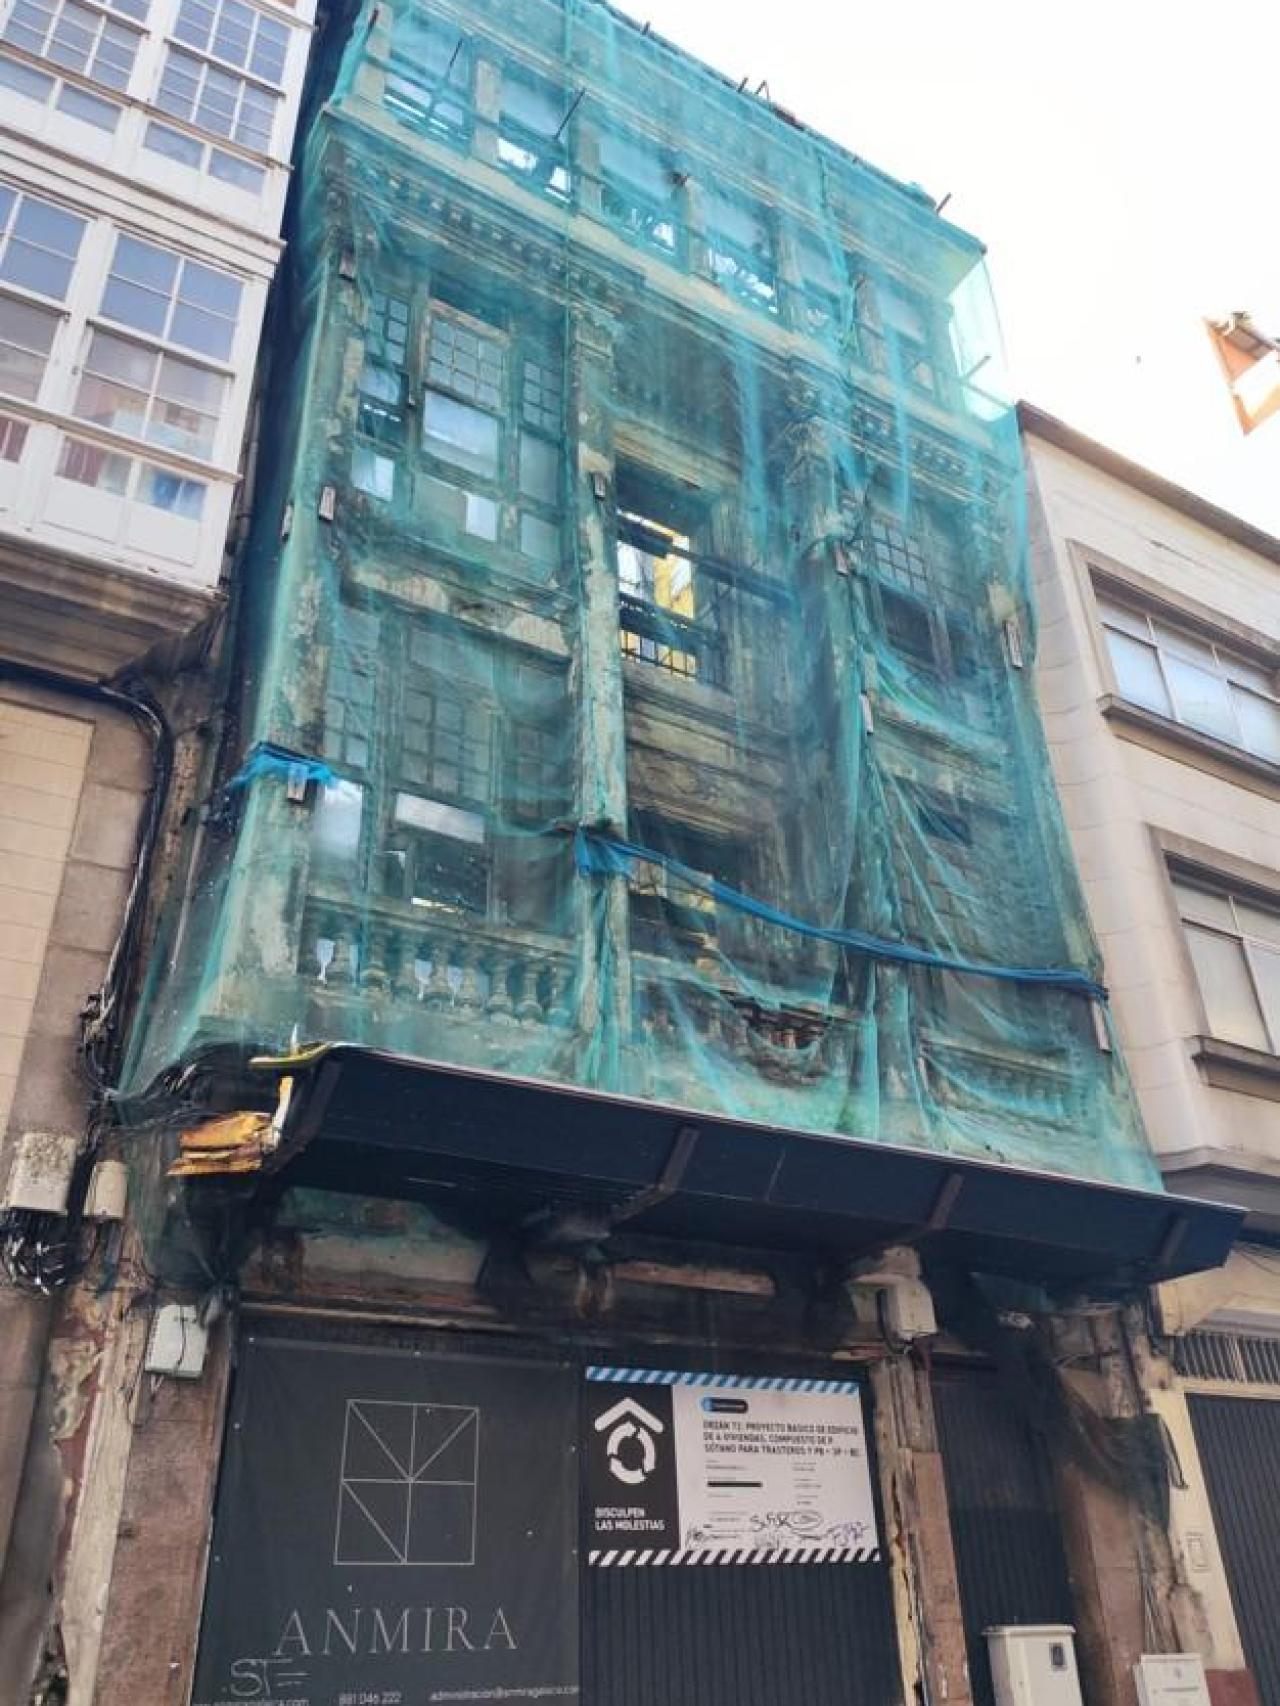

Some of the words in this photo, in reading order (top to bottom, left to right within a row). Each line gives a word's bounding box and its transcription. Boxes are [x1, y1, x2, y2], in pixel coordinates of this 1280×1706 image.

[746, 1422, 785, 1432] PROYECTO
[738, 1444, 759, 1454] PARA
[595, 1506, 645, 1518] DISCULPEN
[595, 1519, 614, 1531] LAS
[615, 1519, 665, 1531] MOLESTIAS
[272, 1607, 519, 1656] ANMIRA
